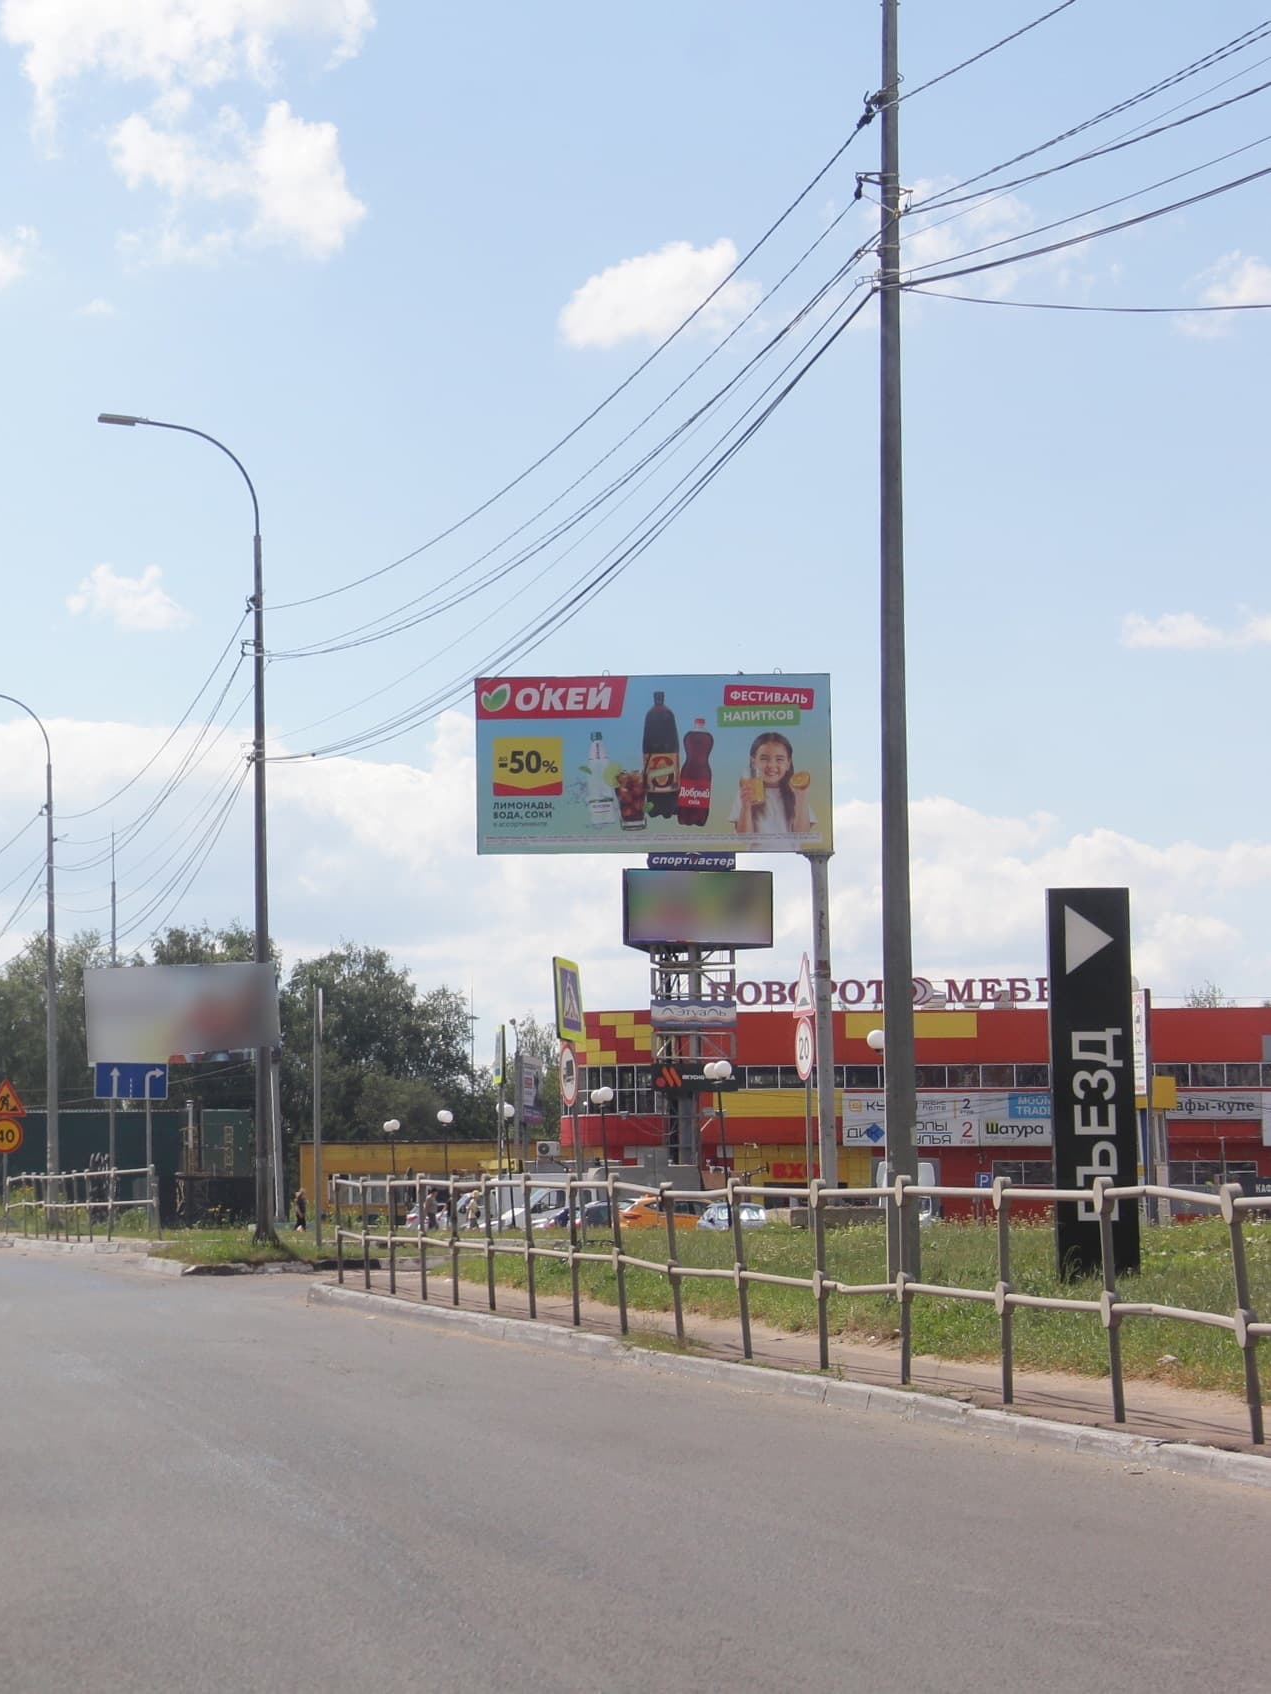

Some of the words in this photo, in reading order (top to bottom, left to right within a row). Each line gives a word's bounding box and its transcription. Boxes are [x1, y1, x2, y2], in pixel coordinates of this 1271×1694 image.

[730, 690, 808, 704] ФЕСТИВАЛЬ
[723, 710, 794, 721] НАПИТКОВ
[679, 786, 710, 798] Добрый
[492, 801, 555, 811] ЛИМОНАДЫ,
[493, 811, 523, 820] ВОДА,
[524, 810, 552, 818] СОКИ
[799, 1036, 810, 1060] 20
[962, 1098, 971, 1110] 2
[1164, 1098, 1255, 1115] афы-купе
[1016, 1106, 1050, 1116] TRAD
[962, 1121, 973, 1138] 2
[986, 1122, 1044, 1138] Шатура
